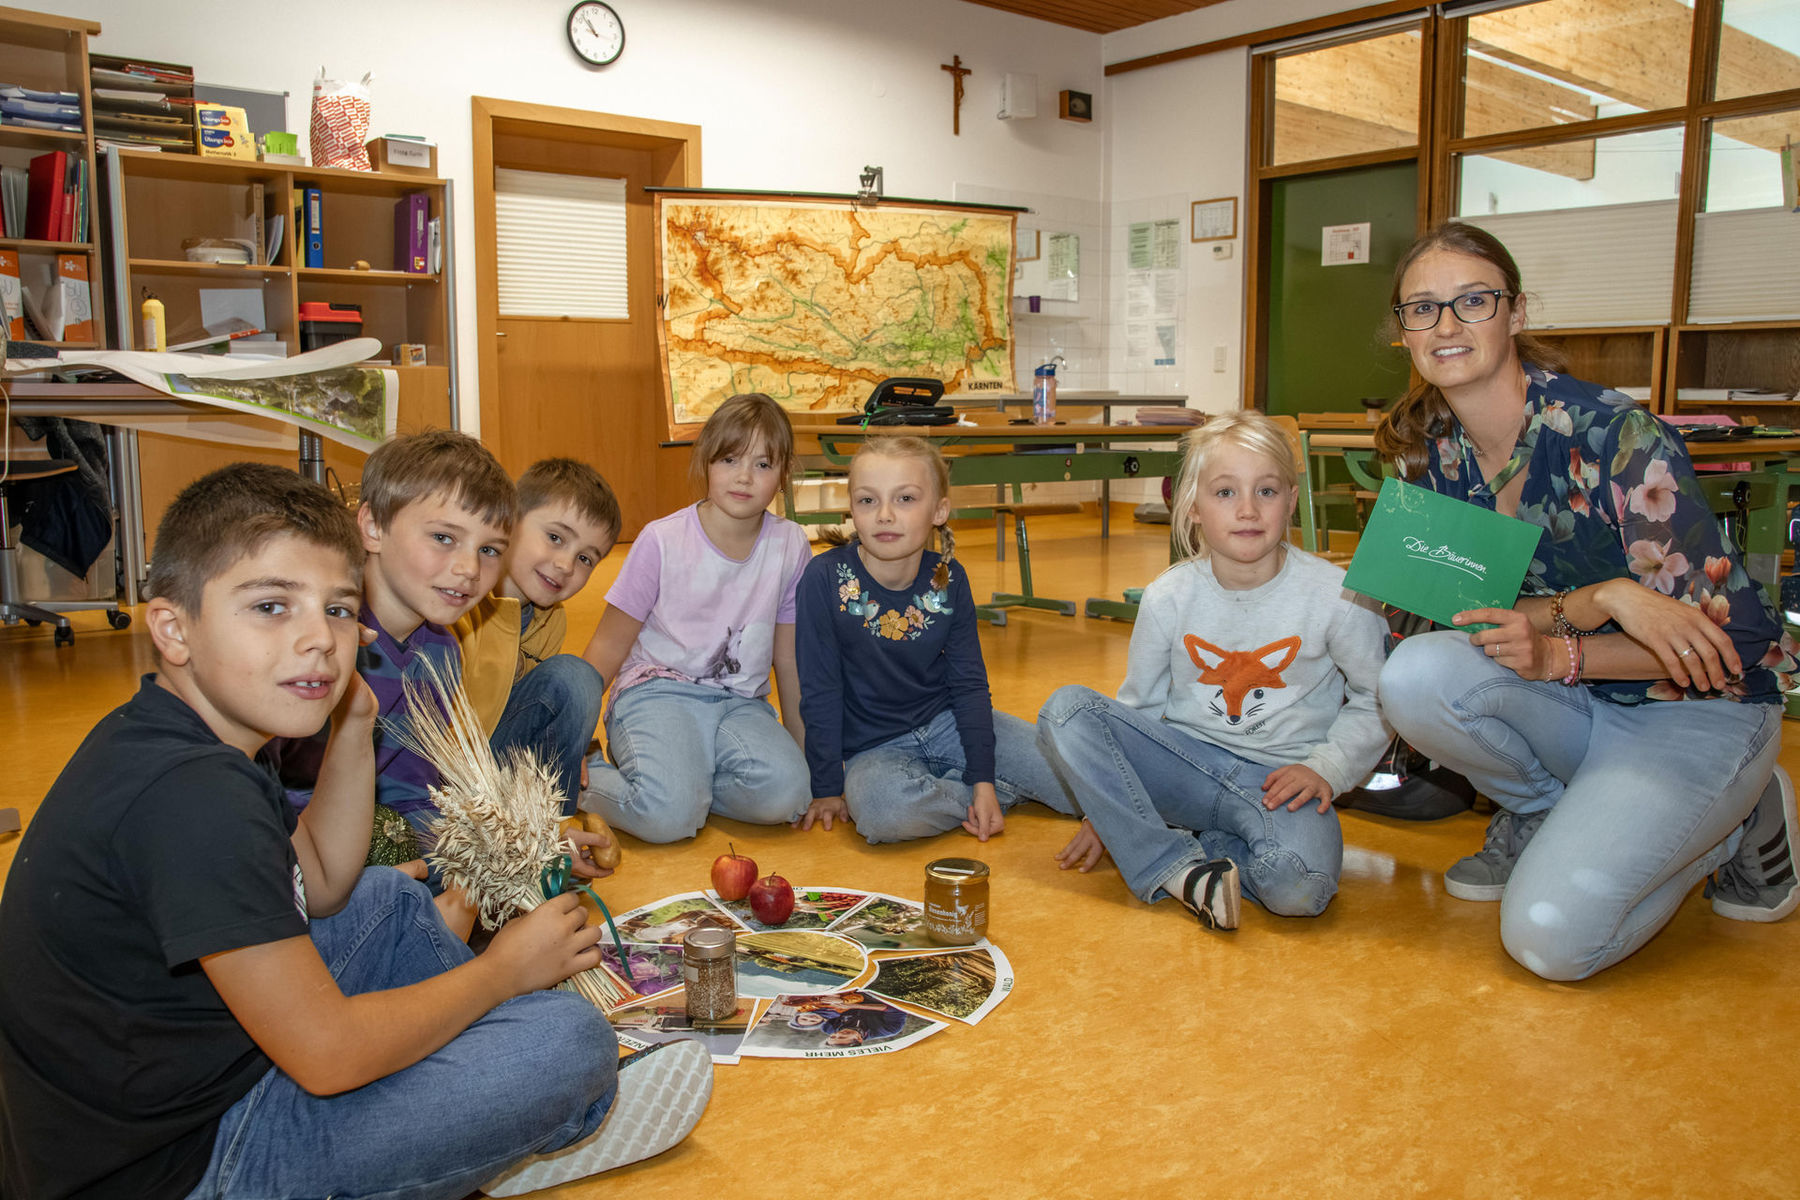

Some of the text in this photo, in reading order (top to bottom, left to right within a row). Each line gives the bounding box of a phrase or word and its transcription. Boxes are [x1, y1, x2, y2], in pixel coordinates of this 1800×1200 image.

[657, 293, 669, 310] W
[1403, 536, 1429, 553] Die
[1002, 977, 1013, 991] WALD
[847, 1045, 893, 1056] VIELES
